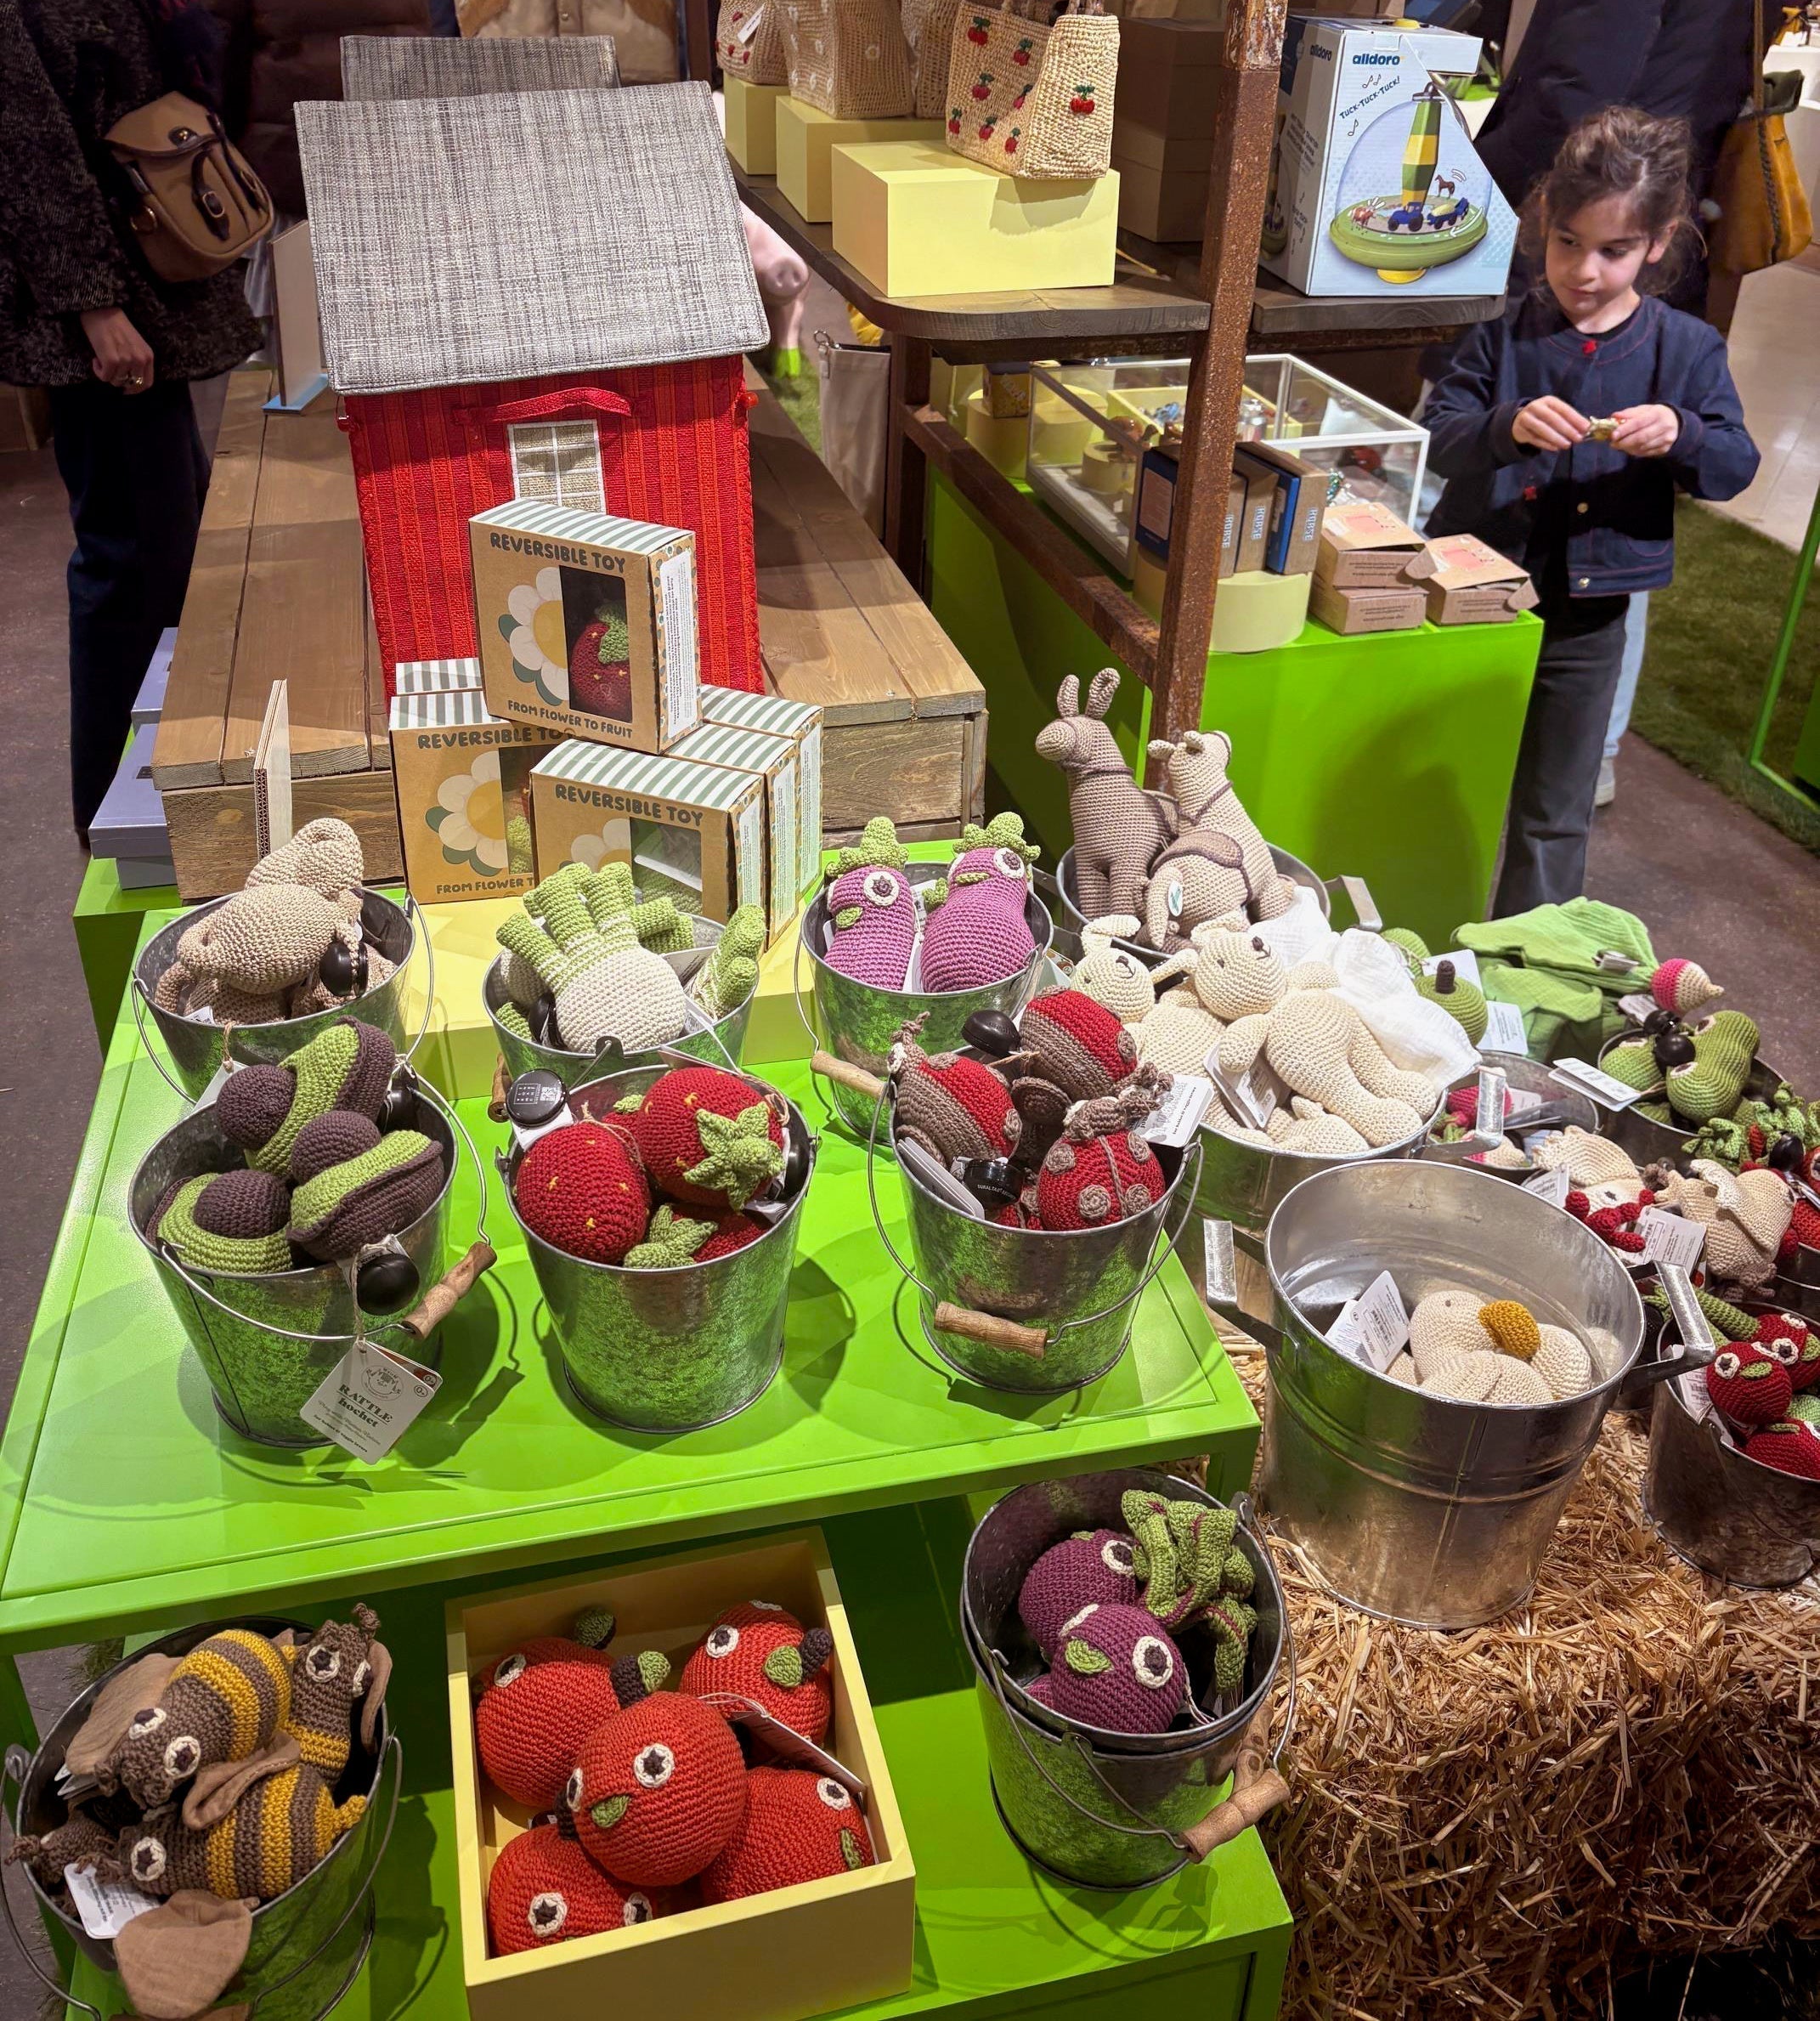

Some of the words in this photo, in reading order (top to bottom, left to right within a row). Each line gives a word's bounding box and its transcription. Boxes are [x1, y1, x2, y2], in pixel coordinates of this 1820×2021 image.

[1353, 54, 1400, 65] alldoro
[490, 532, 588, 566] REVERSIBLE
[591, 552, 625, 574] TOY
[508, 700, 537, 716] FROM
[540, 708, 581, 727] FLOWER
[584, 718, 599, 730] TO
[601, 722, 633, 739] FRUIT
[418, 727, 532, 750] REVERSIBLE
[556, 784, 662, 819] REVERSIBLE
[666, 806, 704, 827] TOY
[437, 882, 472, 894] FROM
[475, 878, 523, 891] FLOWER
[526, 877, 534, 886] T
[338, 1384, 393, 1423] RATTLE
[338, 1397, 379, 1428] hochet
